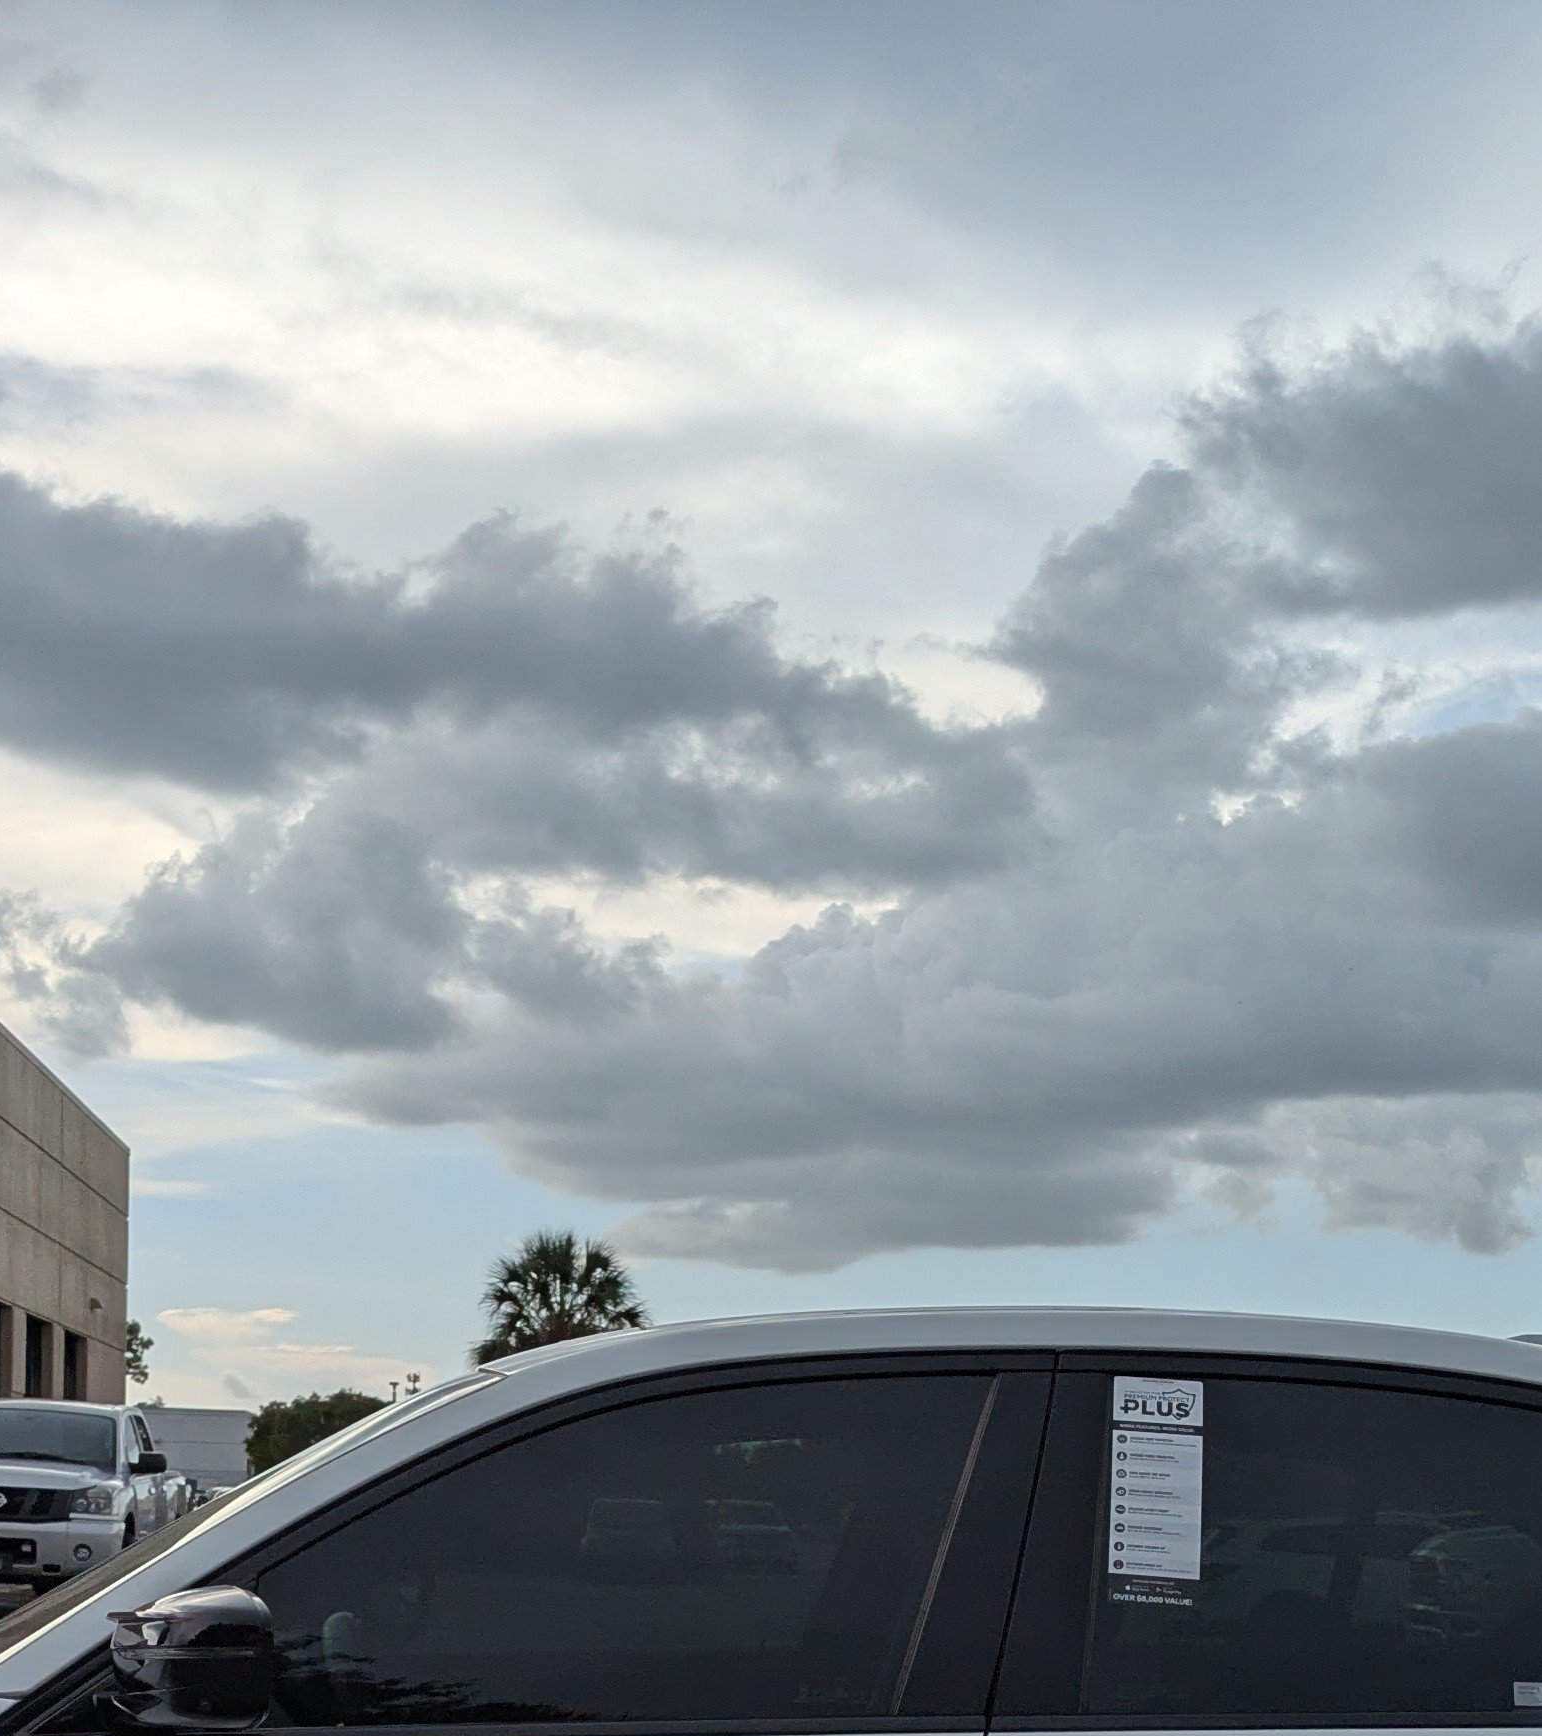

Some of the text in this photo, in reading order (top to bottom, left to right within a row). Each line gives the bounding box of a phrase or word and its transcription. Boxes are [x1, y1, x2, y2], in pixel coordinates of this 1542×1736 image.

[1124, 1393, 1190, 1403] PREMIUM PROTECT
[1120, 1399, 1190, 1418] PLUS
[1113, 1593, 1135, 1601] OVER
